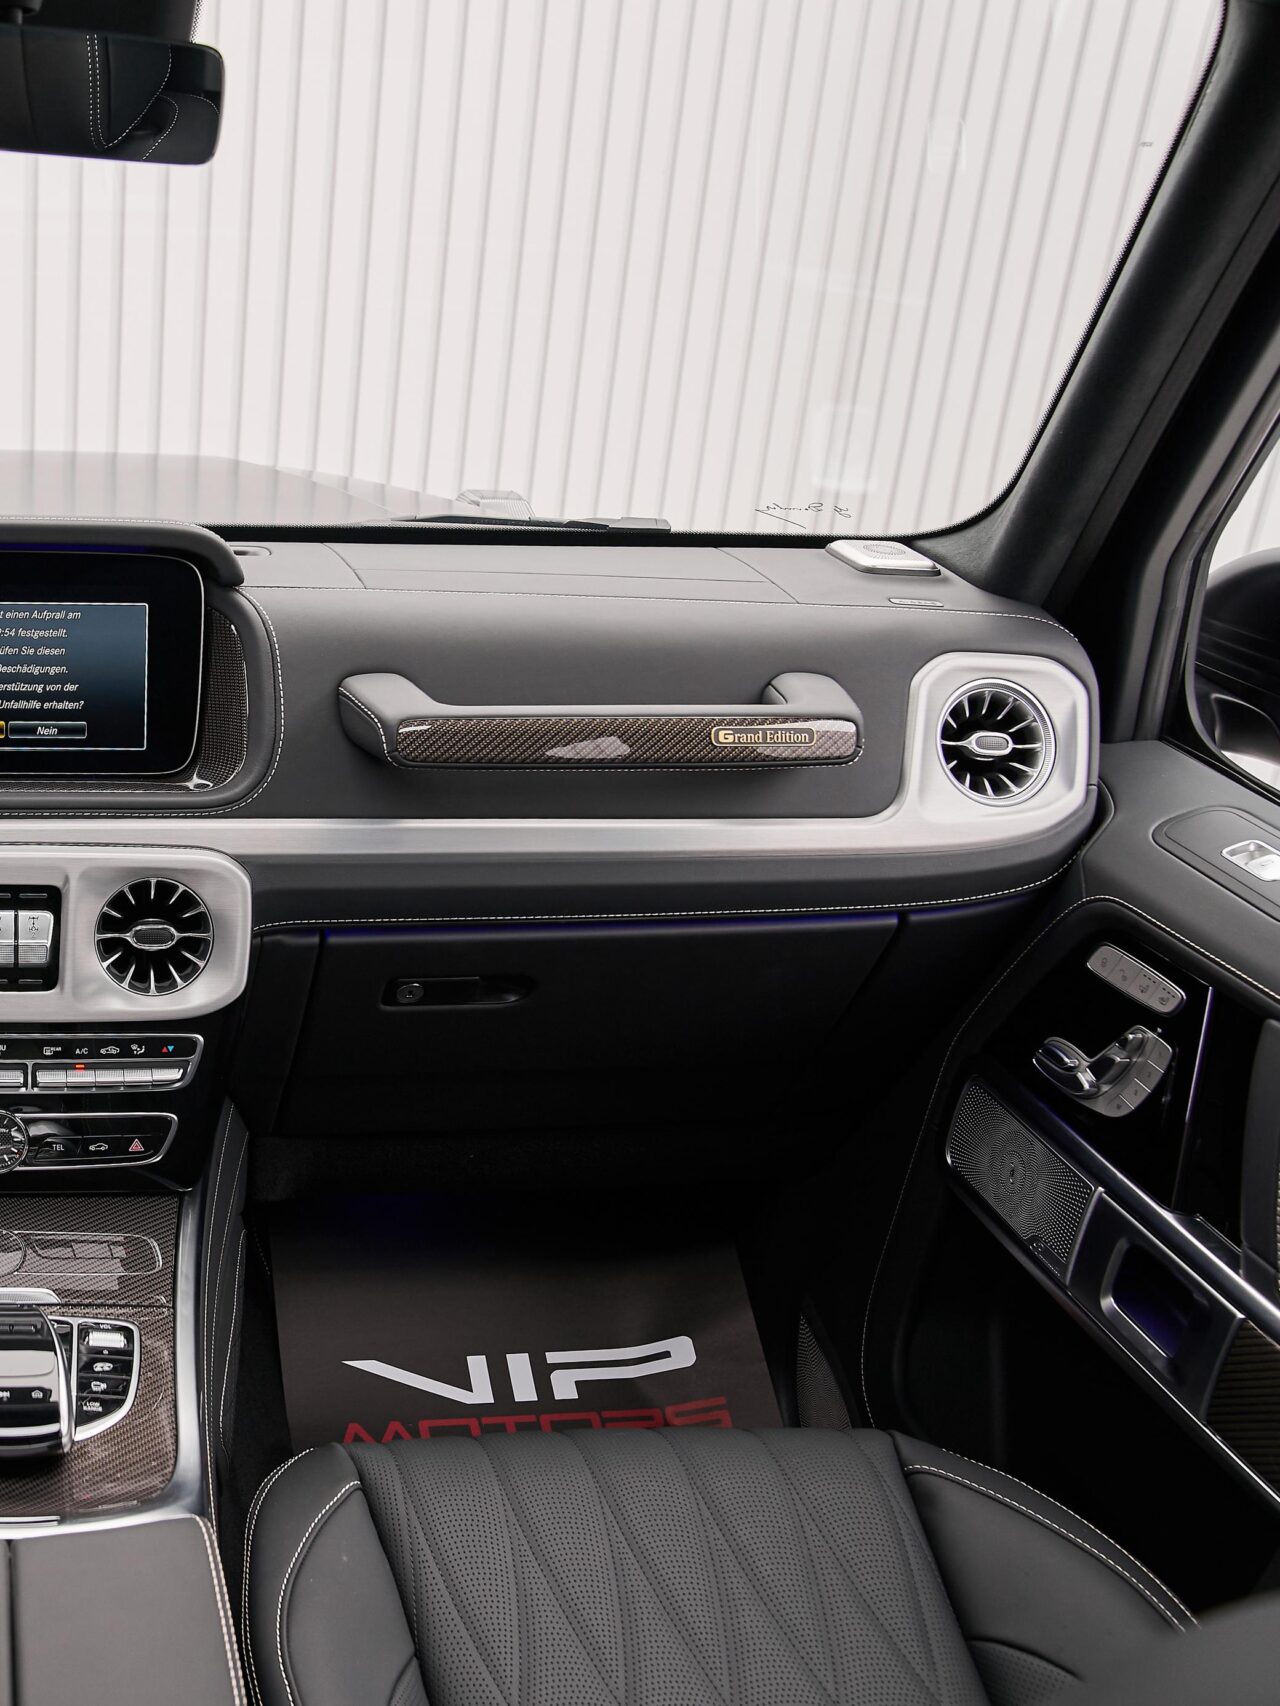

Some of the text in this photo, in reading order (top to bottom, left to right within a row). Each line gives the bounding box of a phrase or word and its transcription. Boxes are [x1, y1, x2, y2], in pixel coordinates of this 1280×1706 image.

[5, 609, 29, 619] einen
[31, 609, 66, 621] Aufprall
[67, 611, 81, 619] am
[17, 628, 68, 639] festgestellt.
[20, 645, 35, 655] Sie
[36, 646, 66, 655] diesen
[46, 683, 61, 691] von
[63, 682, 80, 691] der
[43, 700, 84, 710] erhalten?
[36, 726, 58, 735] Nein
[718, 730, 809, 743] Grand Edition
[75, 1047, 89, 1055] A/C
[342, 1335, 697, 1405] VIP
